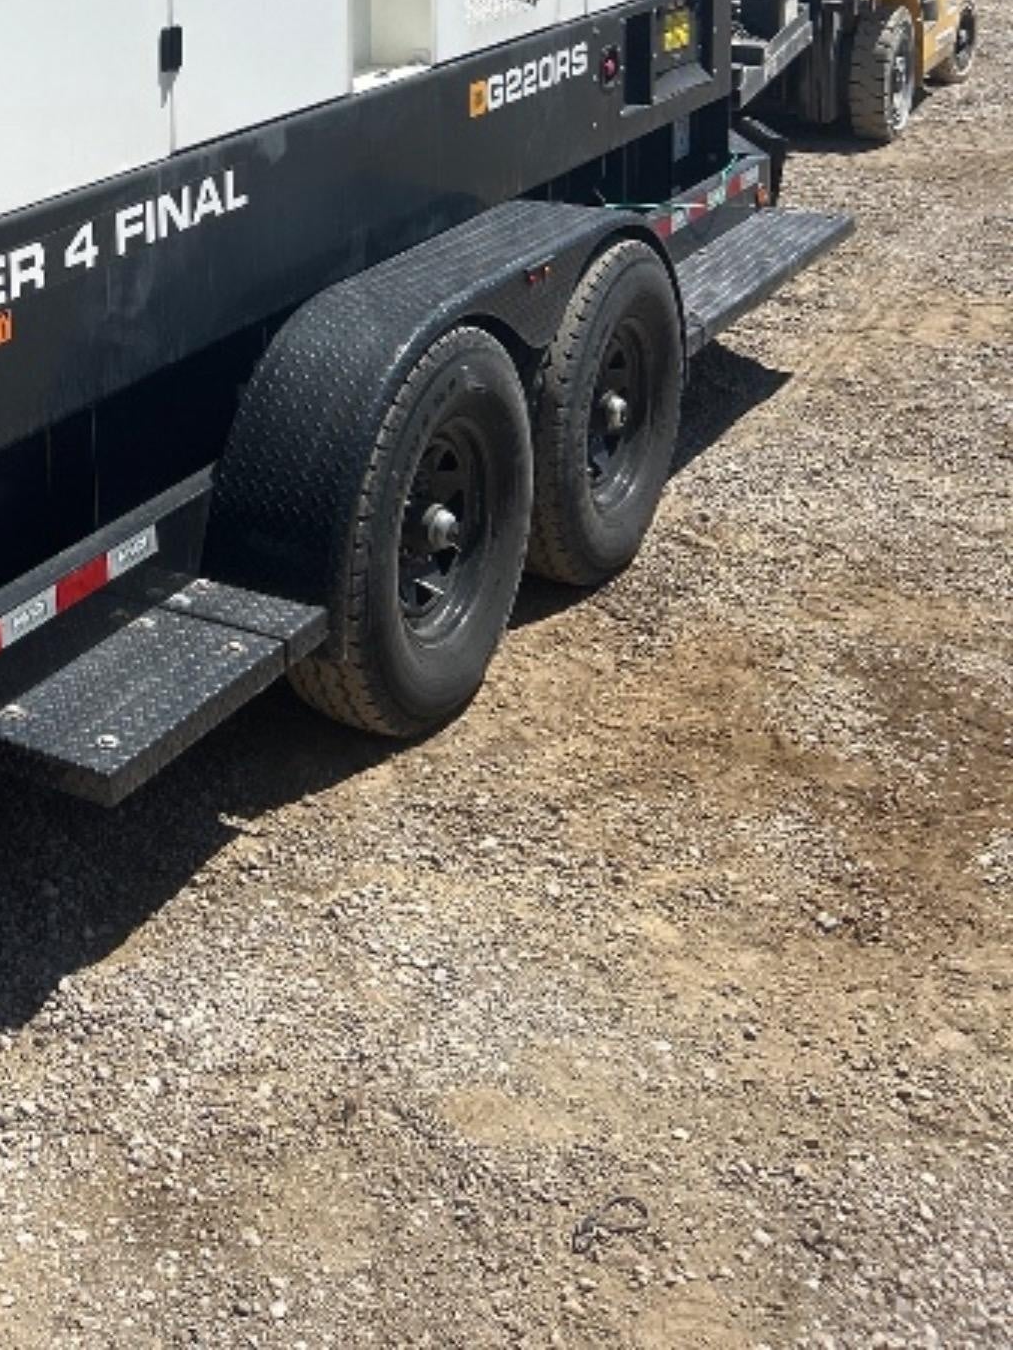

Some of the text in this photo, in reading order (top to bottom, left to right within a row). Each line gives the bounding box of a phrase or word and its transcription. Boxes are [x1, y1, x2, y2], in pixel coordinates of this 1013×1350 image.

[486, 41, 589, 112] G220RS
[64, 220, 100, 269] 4
[115, 169, 250, 257] FINAL
